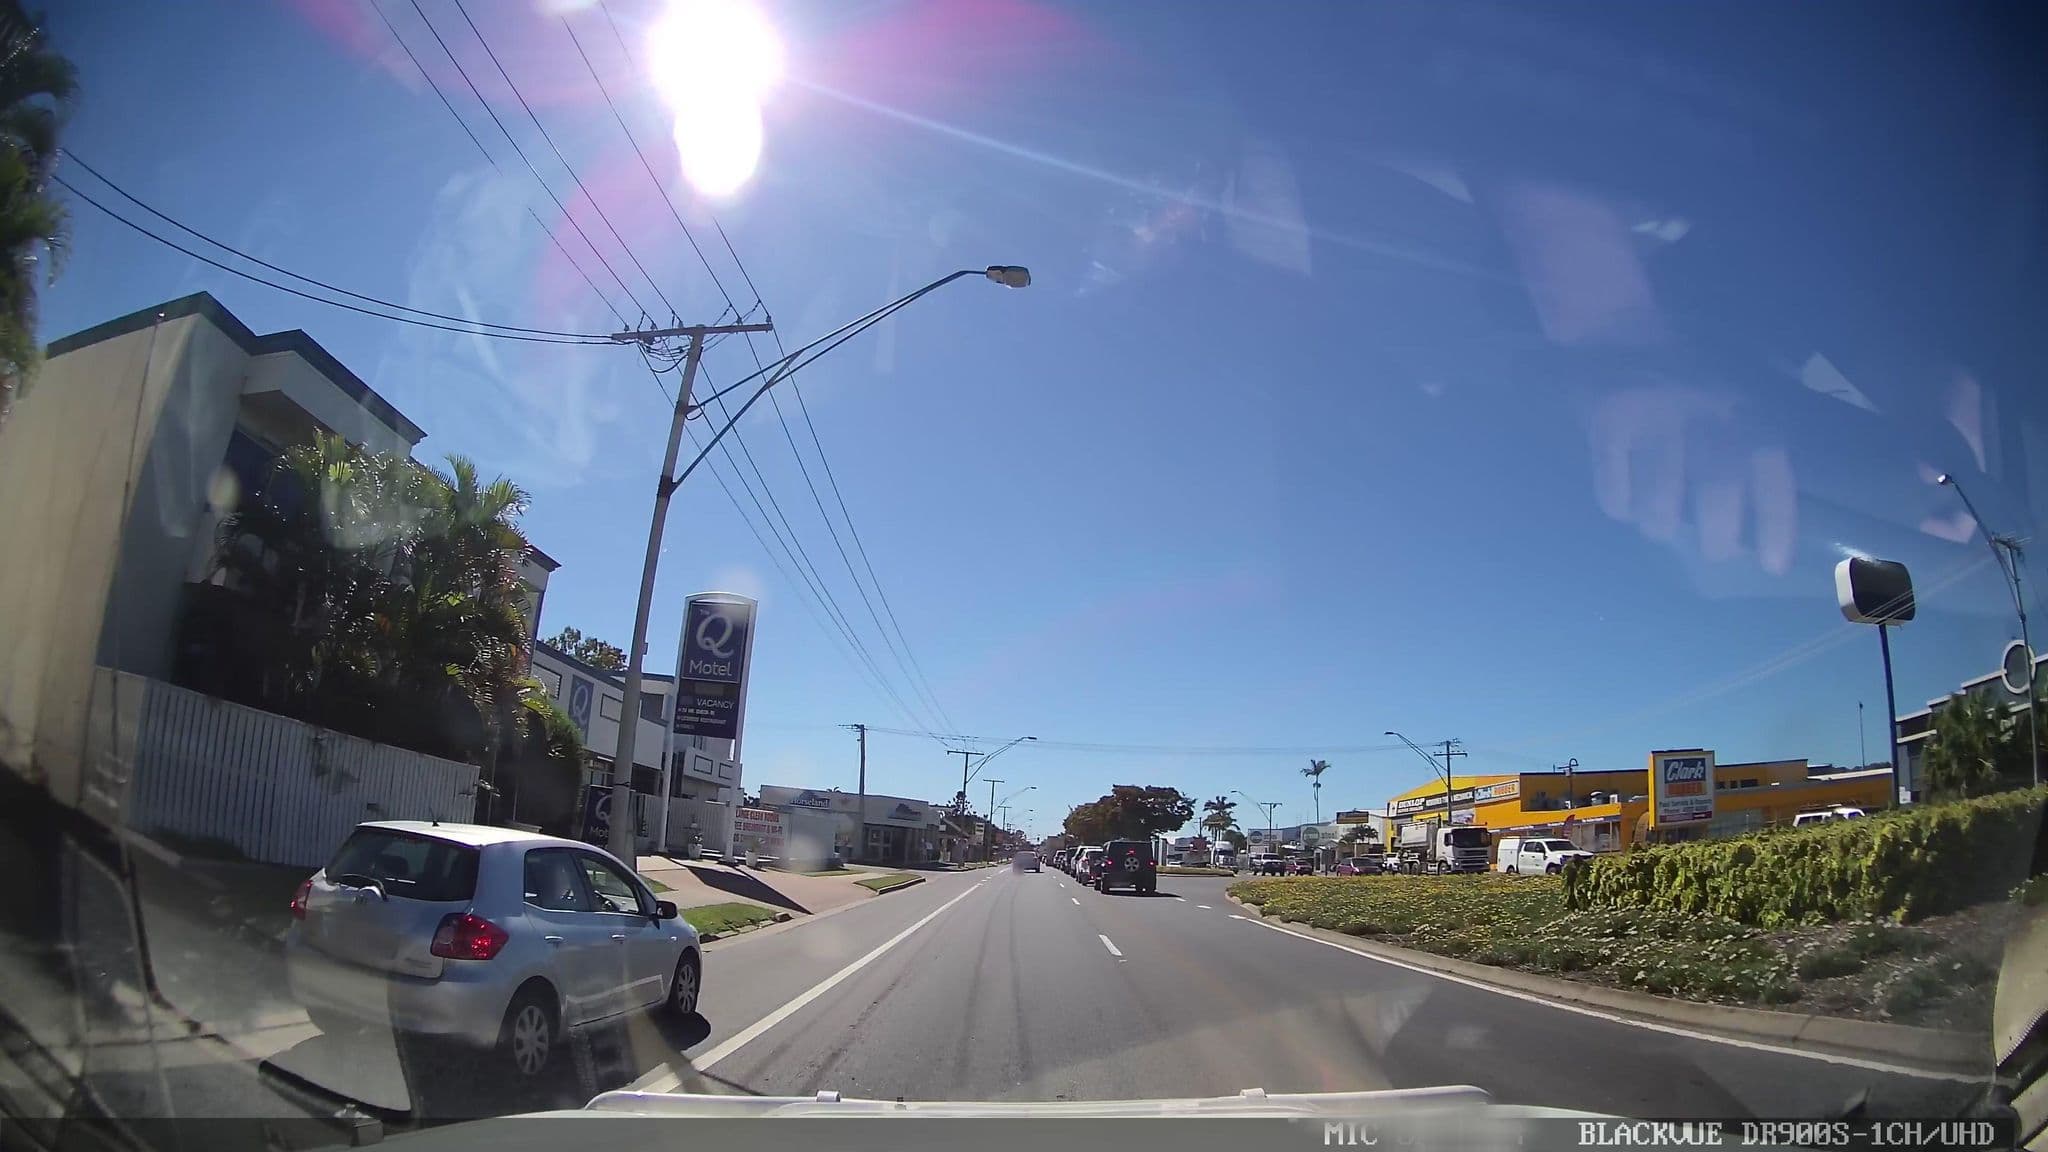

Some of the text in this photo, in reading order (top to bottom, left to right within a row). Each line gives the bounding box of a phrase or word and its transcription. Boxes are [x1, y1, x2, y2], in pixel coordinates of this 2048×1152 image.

[695, 614, 734, 658] Q
[689, 660, 732, 676] Motel
[696, 698, 734, 709] VACANCY
[1667, 761, 1704, 781] Clark
[1398, 798, 1425, 808] DUNLOP
